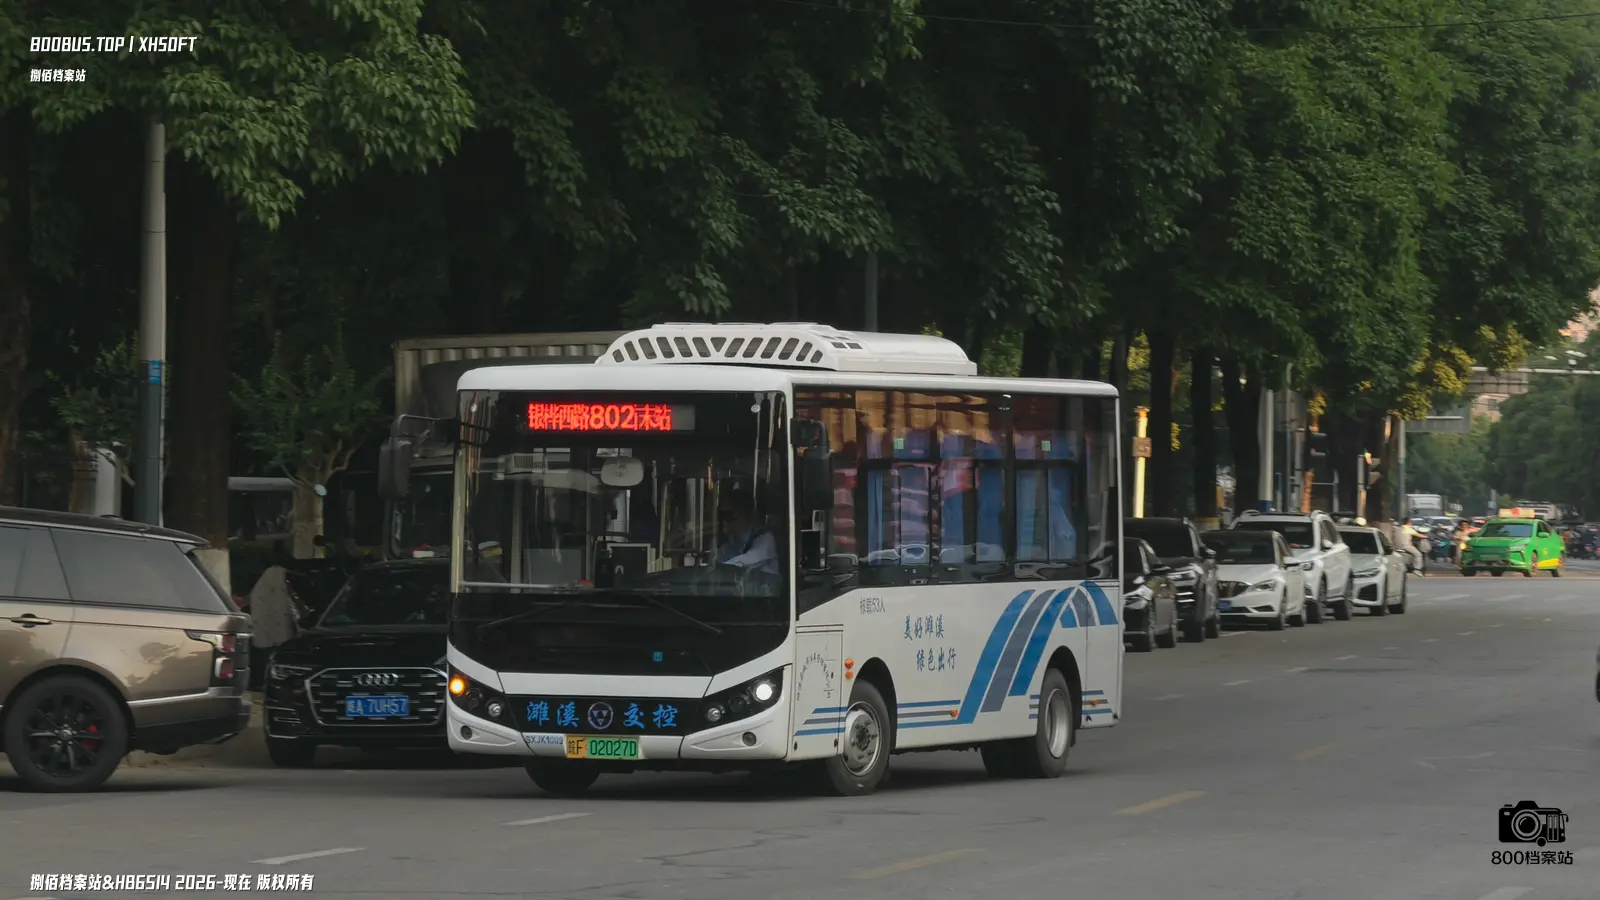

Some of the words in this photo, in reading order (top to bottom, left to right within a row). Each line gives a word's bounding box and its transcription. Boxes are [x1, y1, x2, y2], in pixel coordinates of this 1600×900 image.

[904, 614, 945, 640] 美好濉溪
[916, 648, 957, 672] 绿色出行
[589, 739, 637, 757] 02027D
